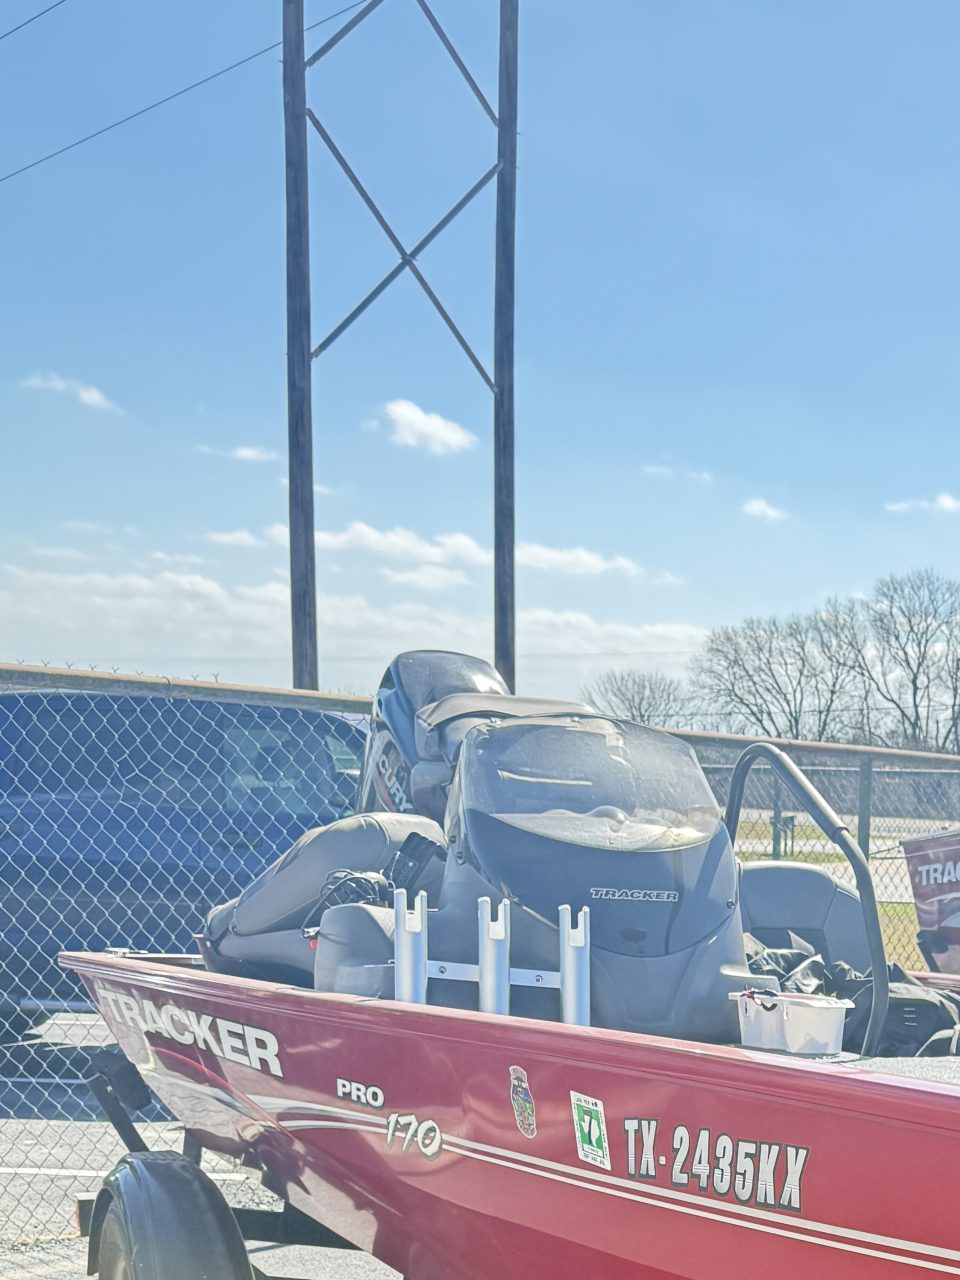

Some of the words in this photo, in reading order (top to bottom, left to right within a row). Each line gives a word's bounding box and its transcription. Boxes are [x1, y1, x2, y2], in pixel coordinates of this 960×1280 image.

[590, 888, 679, 902] TRACKER
[100, 989, 284, 1078] TRACKER
[336, 1077, 385, 1108] PRO
[387, 1112, 443, 1159] 170
